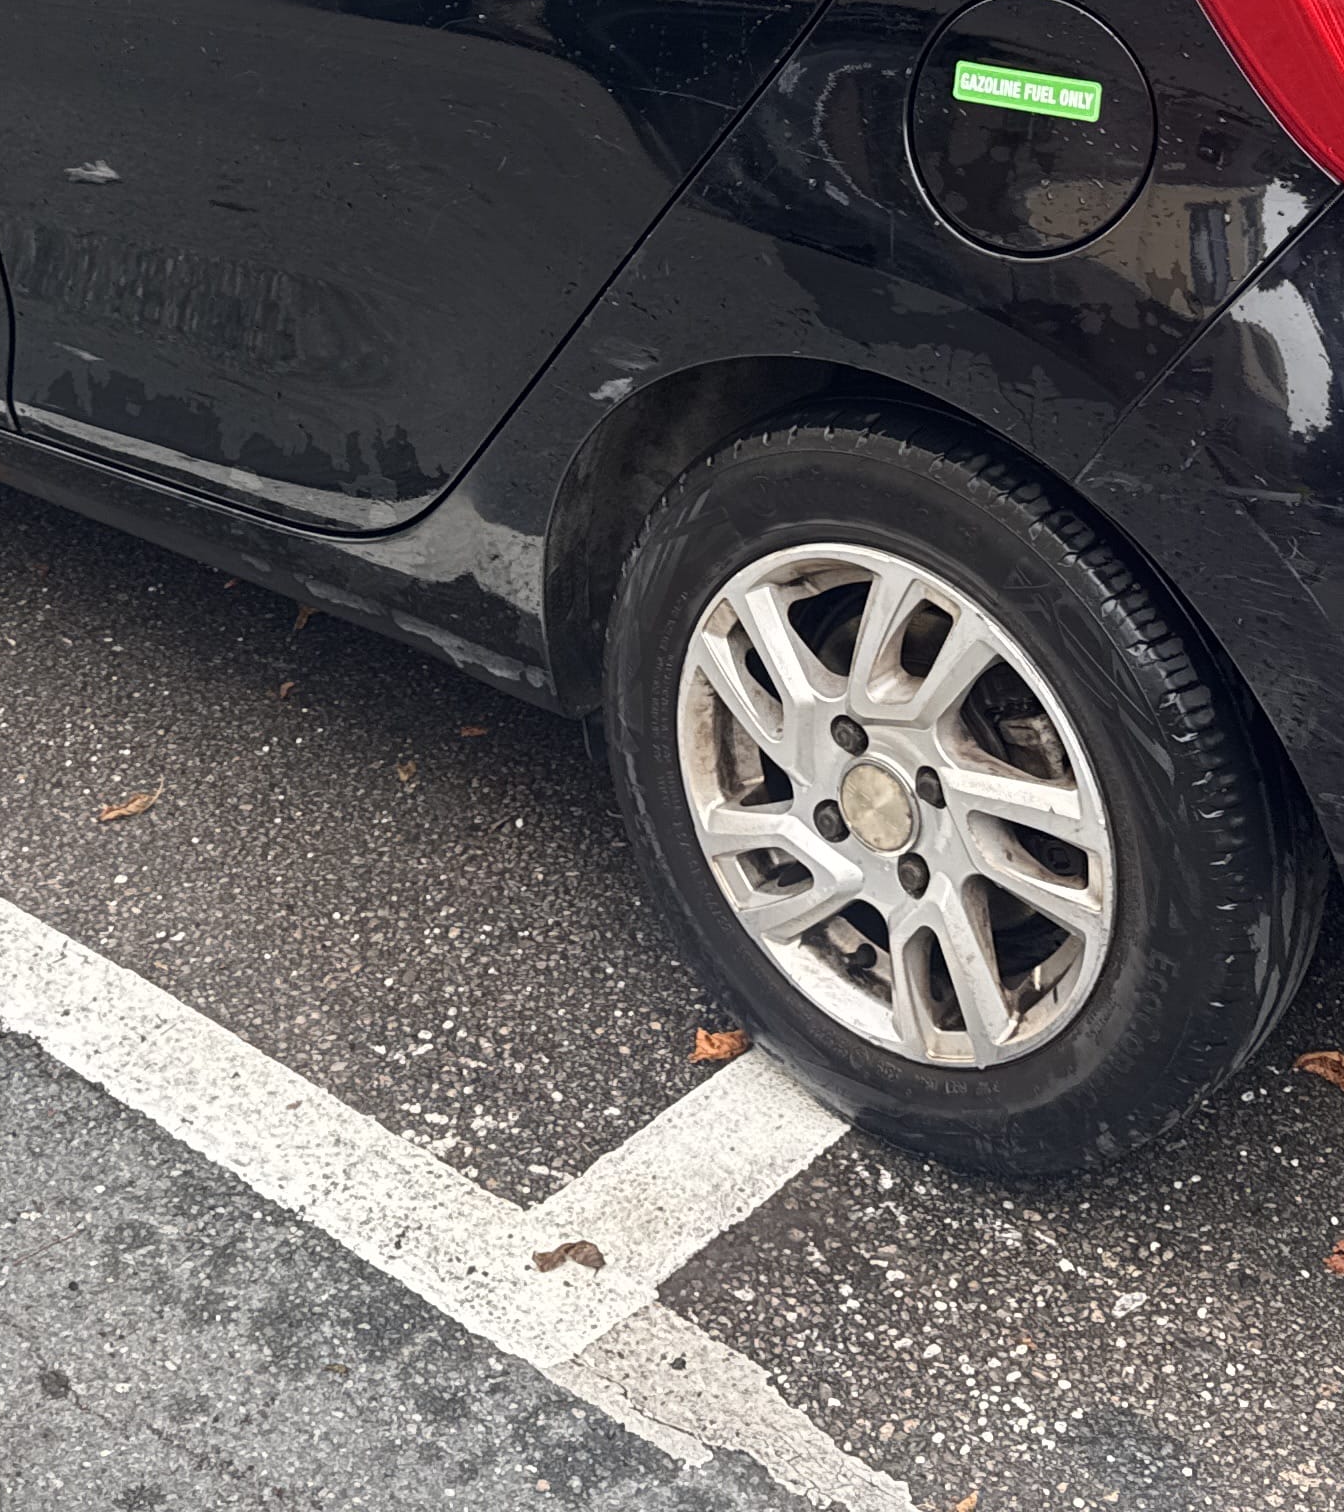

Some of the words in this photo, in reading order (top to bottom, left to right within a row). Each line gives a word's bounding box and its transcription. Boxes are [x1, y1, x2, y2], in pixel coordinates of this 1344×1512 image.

[960, 72, 1021, 100] GAZOLINE
[1023, 83, 1057, 105] FUEL
[1059, 88, 1095, 111] ONLY
